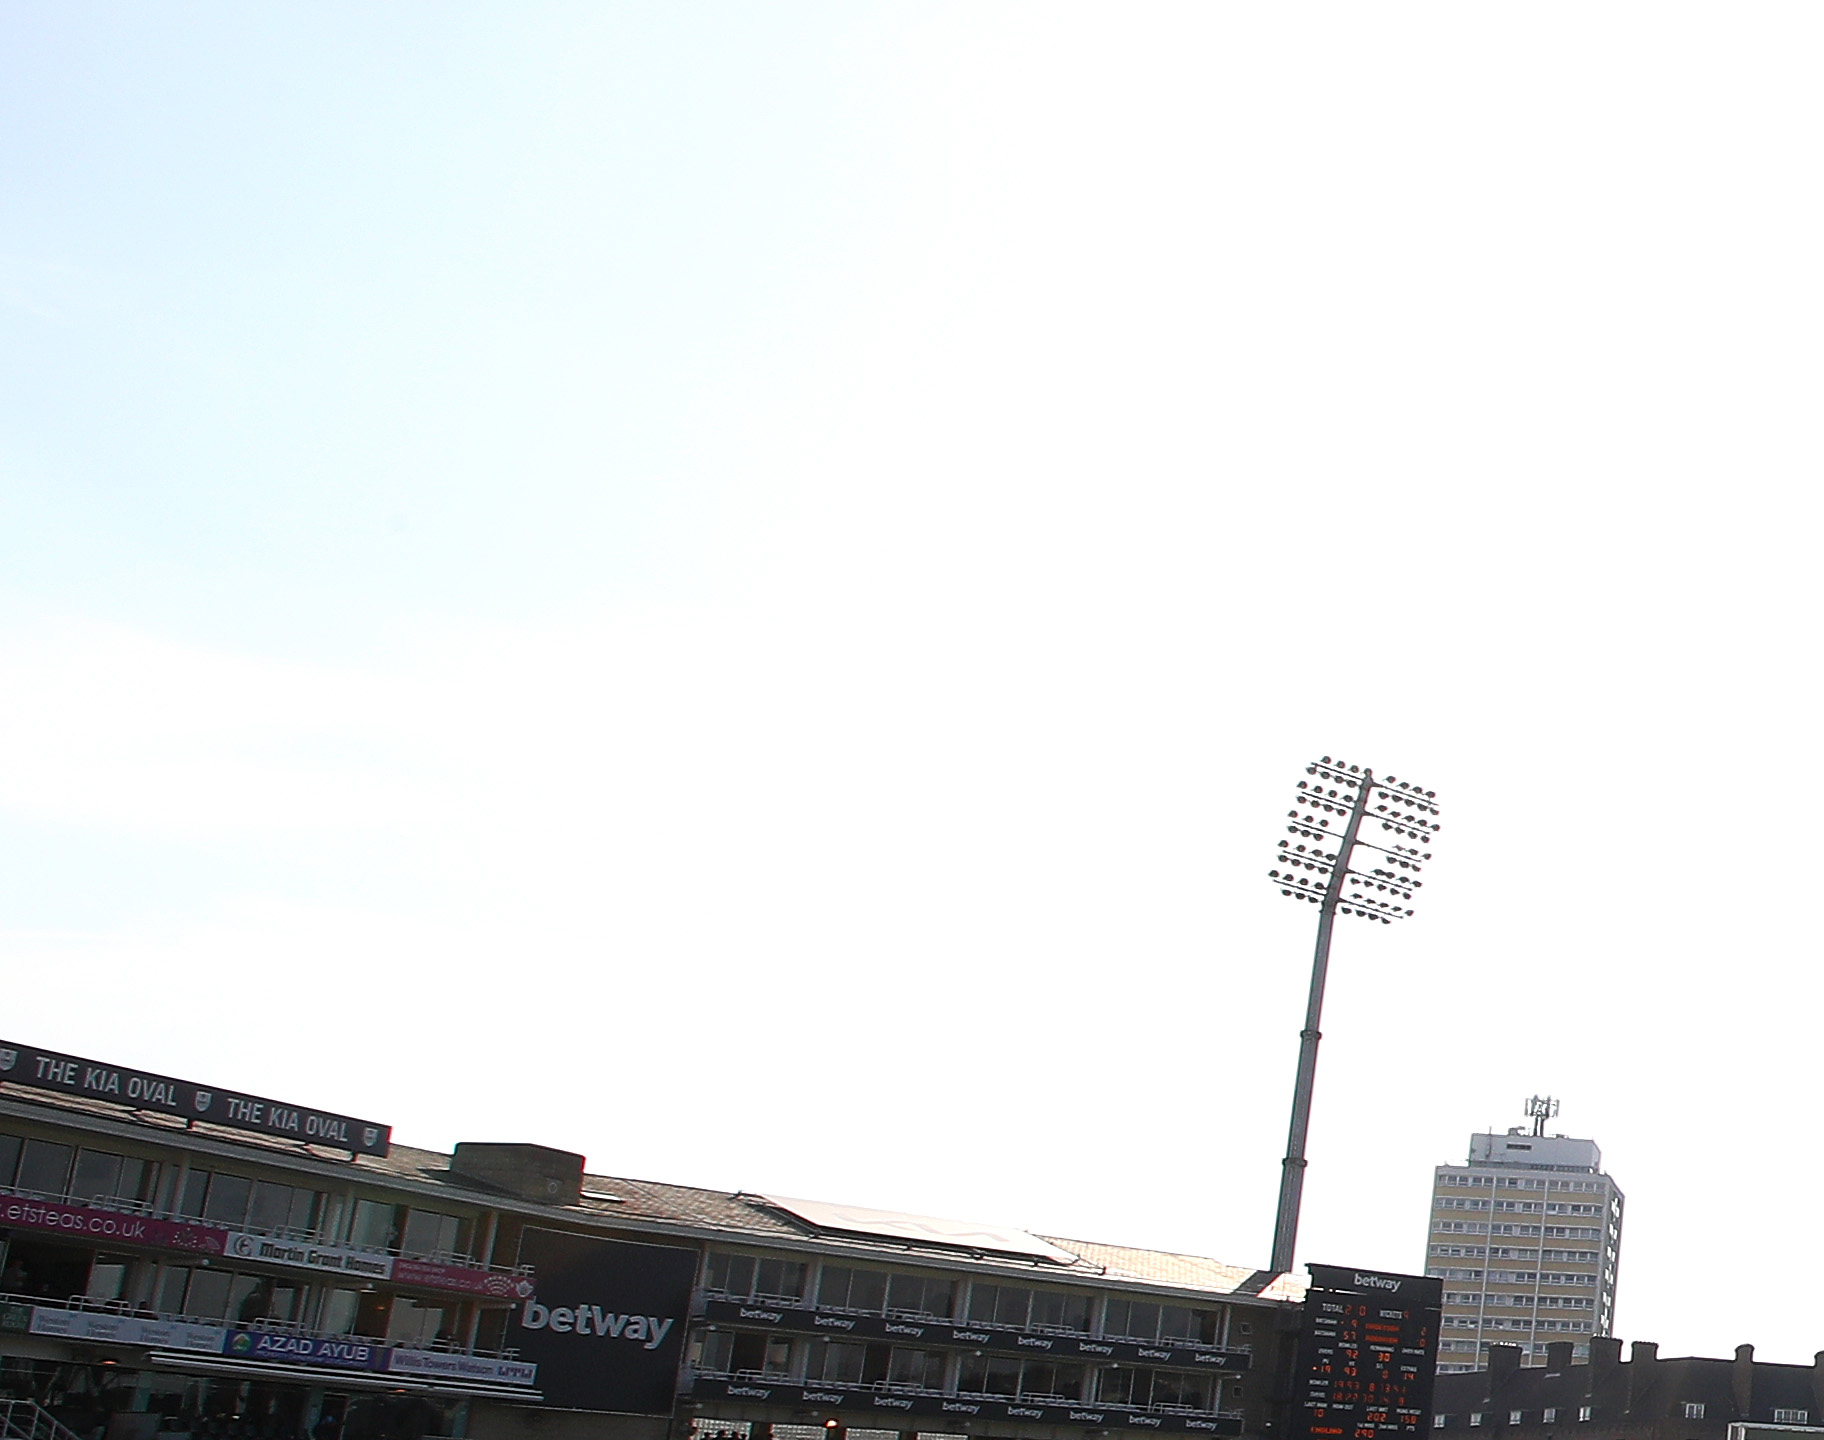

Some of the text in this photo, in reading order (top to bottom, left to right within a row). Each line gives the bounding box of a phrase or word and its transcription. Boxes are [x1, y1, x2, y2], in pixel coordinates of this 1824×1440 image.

[36, 1056, 177, 1107] THE KIA OVAL
[227, 1098, 348, 1143] THE KIA OVAL
[0, 1204, 147, 1239] .etsteas.co.uk
[260, 1241, 304, 1262] Martin
[307, 1251, 342, 1269] Grant
[1354, 1273, 1401, 1293] betway
[740, 1306, 783, 1323] betway
[521, 1296, 674, 1350] betway
[814, 1314, 856, 1331] betway
[885, 1322, 924, 1337] betway
[952, 1329, 990, 1344] betway
[1018, 1335, 1053, 1350] betway
[257, 1336, 313, 1356] AZAD
[319, 1343, 370, 1362] AYUB
[1079, 1341, 1114, 1356] betway
[1138, 1347, 1171, 1362] betway
[1195, 1352, 1227, 1366] betway
[727, 1385, 771, 1400] betway
[802, 1390, 844, 1405] betway
[874, 1395, 913, 1411] betway
[942, 1401, 980, 1415] betway
[1007, 1406, 1044, 1420] betway
[1069, 1410, 1105, 1424] betway
[1128, 1415, 1162, 1428] betway
[1185, 1419, 1218, 1432] betway
